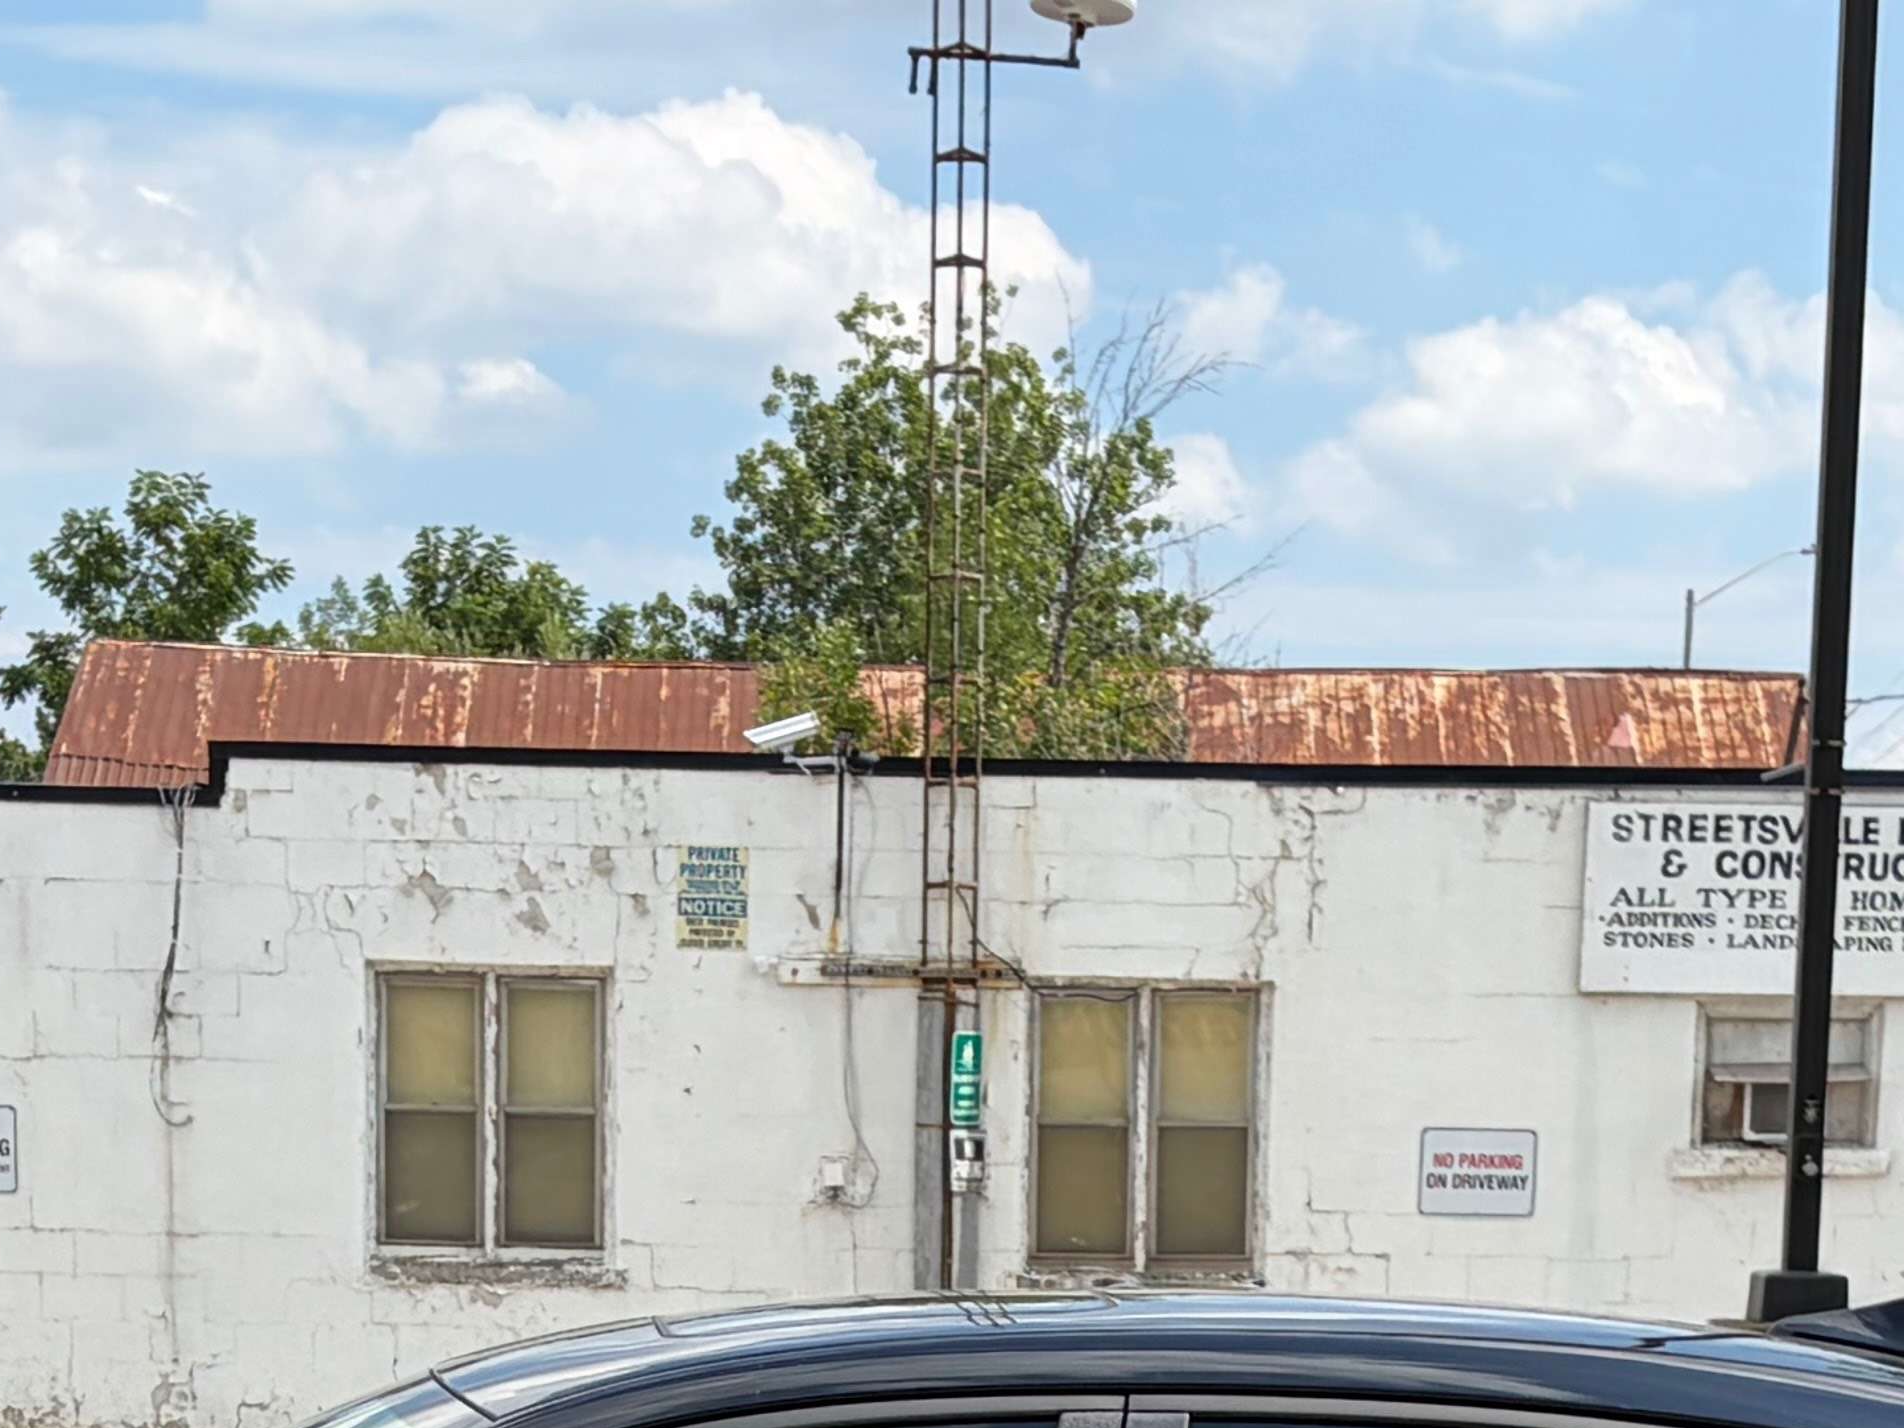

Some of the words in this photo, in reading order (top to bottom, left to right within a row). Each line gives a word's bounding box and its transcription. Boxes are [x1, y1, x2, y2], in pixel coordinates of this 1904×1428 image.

[1612, 812, 1880, 846] STREETSVLE
[688, 847, 739, 862] PRIVATE
[679, 863, 746, 879] PROPERTY
[1661, 849, 1687, 878] &
[1610, 887, 1676, 908] ALL
[1696, 888, 1787, 909] TYPE
[681, 900, 744, 915] NOTICE
[1606, 912, 1716, 928] ADDITIONS
[1603, 931, 1694, 948] STONES
[1433, 1152, 1454, 1169] NO
[1459, 1153, 1523, 1170] PARKING
[1426, 1172, 1448, 1189] ON
[1451, 1173, 1529, 1191] DRIVEWAY
